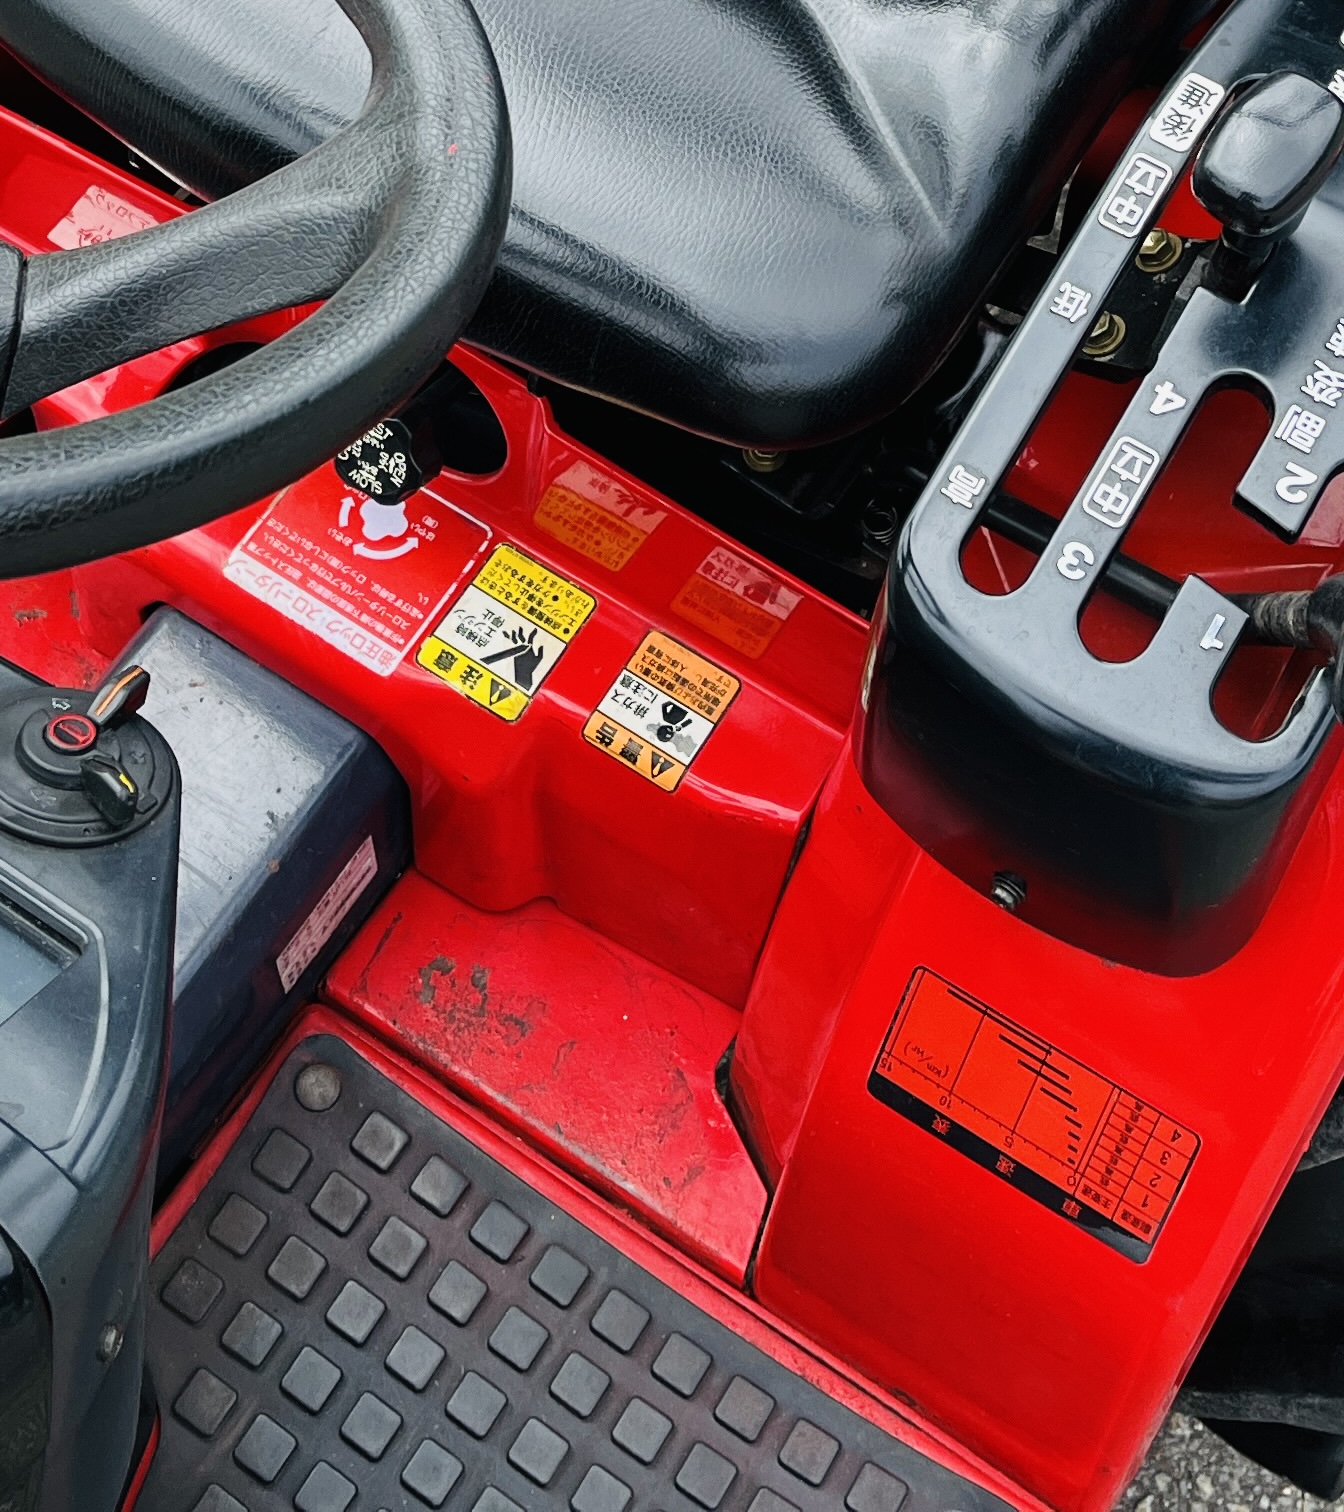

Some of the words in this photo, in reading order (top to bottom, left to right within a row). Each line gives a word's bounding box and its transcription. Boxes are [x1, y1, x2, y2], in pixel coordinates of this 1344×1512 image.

[1158, 76, 1222, 148] 後進
[1105, 160, 1169, 229] 中立
[1049, 282, 1093, 324] 低
[1148, 380, 1187, 416] 4
[348, 468, 383, 495] SLOW
[389, 451, 407, 488] OPEN
[940, 463, 989, 509] 高
[1091, 443, 1156, 518] 中立
[1275, 461, 1319, 506] 2
[323, 525, 355, 547] おそい
[406, 521, 438, 541] はやい
[1056, 541, 1096, 581] 3
[451, 605, 497, 639] エンジン
[479, 607, 505, 629] 停止
[1199, 613, 1226, 651] 1
[453, 622, 490, 650] 点検時
[430, 647, 484, 691] 注意
[608, 687, 649, 720] 排ガス
[617, 672, 659, 705] に注意
[591, 719, 646, 765] 警告
[878, 1056, 894, 1073] 15
[937, 1093, 954, 1109] 10
[1001, 1134, 1015, 1148] 5
[1169, 1128, 1183, 1145] 4
[929, 1113, 1083, 1219] 車速表
[1157, 1149, 1172, 1166] 3
[1064, 1173, 1077, 1187] 0
[1147, 1171, 1161, 1189] 2
[1140, 1193, 1151, 1209] 1
